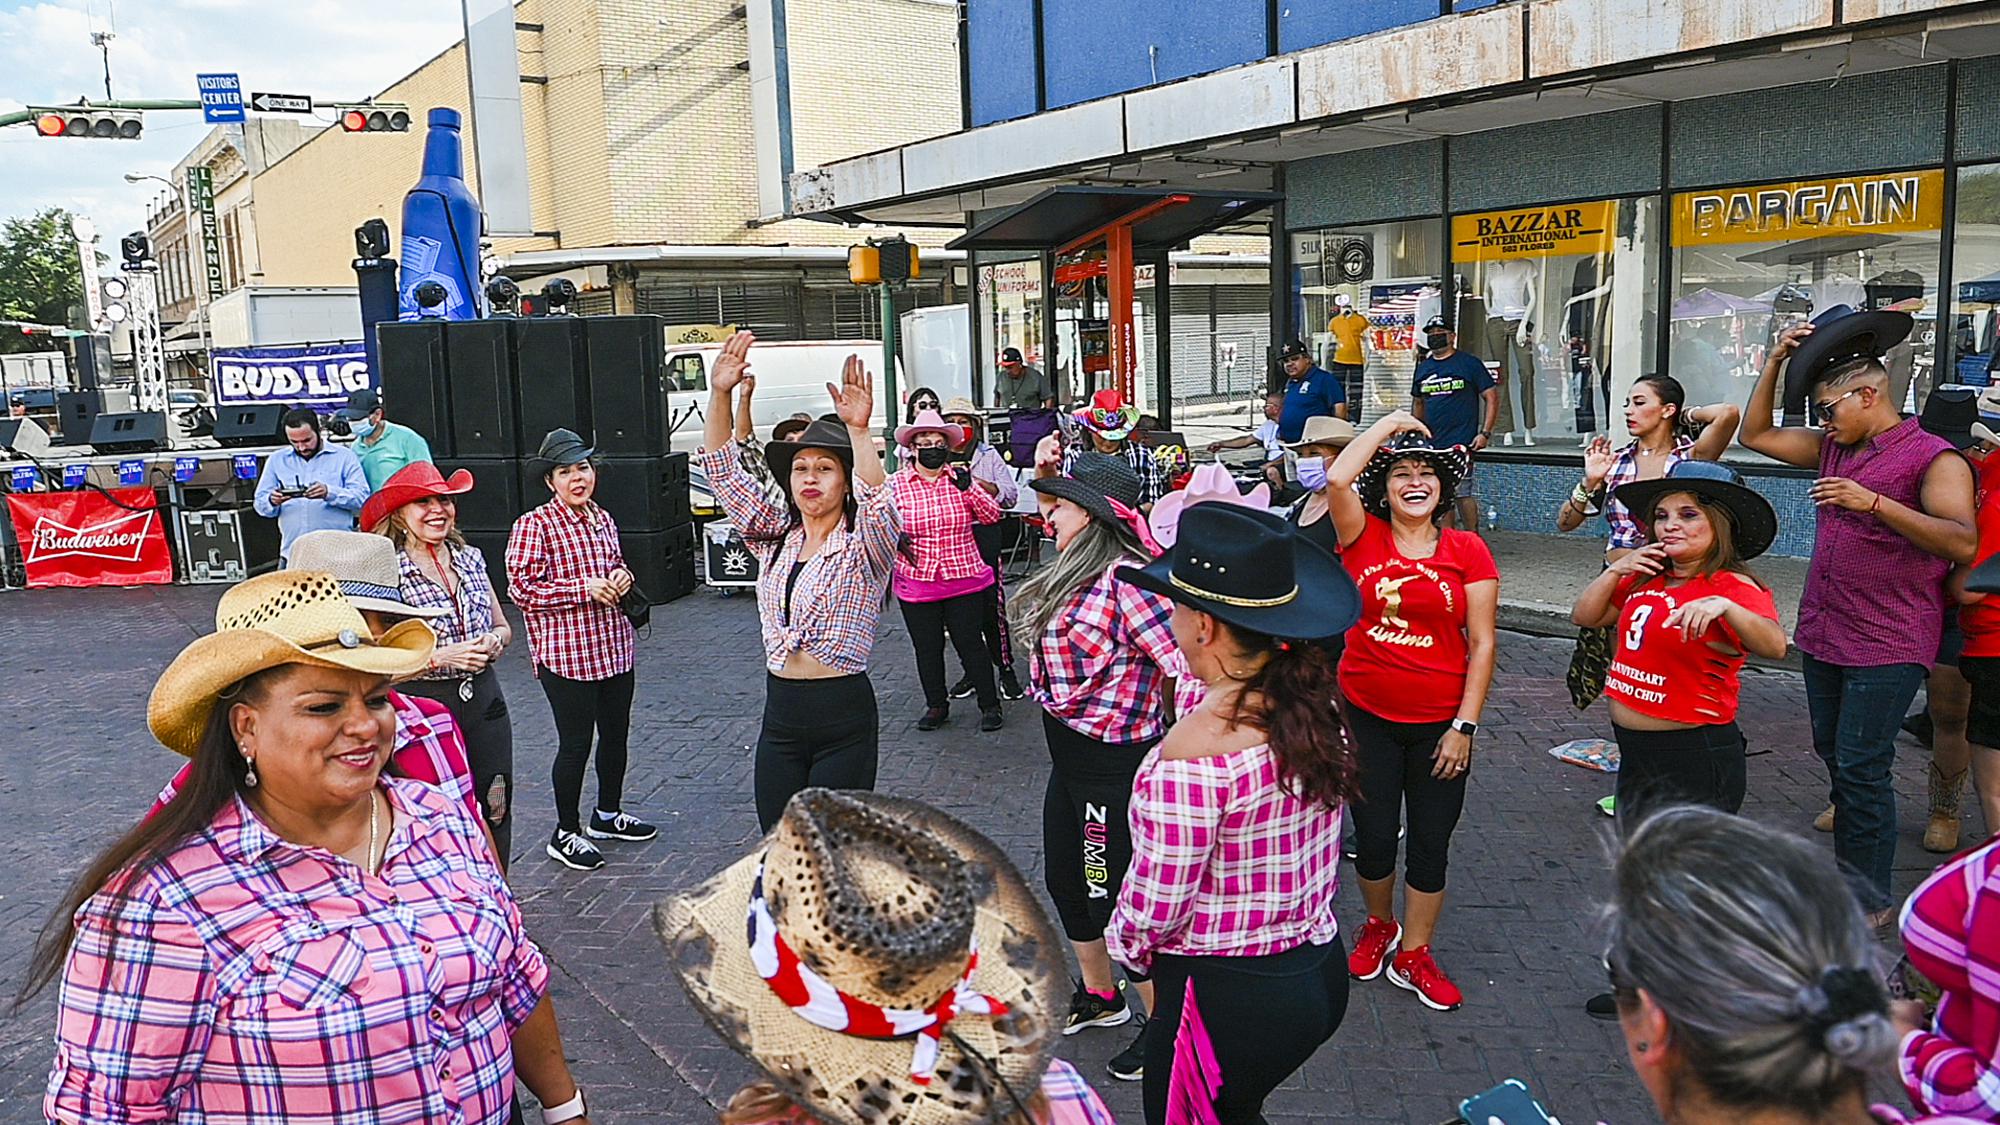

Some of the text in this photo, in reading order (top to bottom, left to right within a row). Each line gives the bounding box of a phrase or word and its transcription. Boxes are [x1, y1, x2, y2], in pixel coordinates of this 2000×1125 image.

[199, 77, 239, 90] VISITORS
[202, 92, 240, 105] CENTER
[269, 99, 287, 107] ONE
[1692, 177, 1919, 236] BARGAIN
[1477, 209, 1583, 237] BAZZAR
[1482, 229, 1576, 248] INTERNATIONAL
[1519, 241, 1555, 251] FLORES
[993, 267, 1025, 280] SCHOOL
[996, 280, 1041, 293] UNIFORMS
[221, 361, 371, 397] BUD LIG
[120, 465, 142, 475] ULTRA
[33, 527, 141, 550] Budweiser
[1364, 563, 1383, 577] the
[1416, 562, 1440, 583] With
[1439, 581, 1455, 613] Chuy
[1625, 604, 1654, 651] 3
[1634, 687, 1667, 704] CHUY
[1084, 802, 1108, 899] ZUMBA
